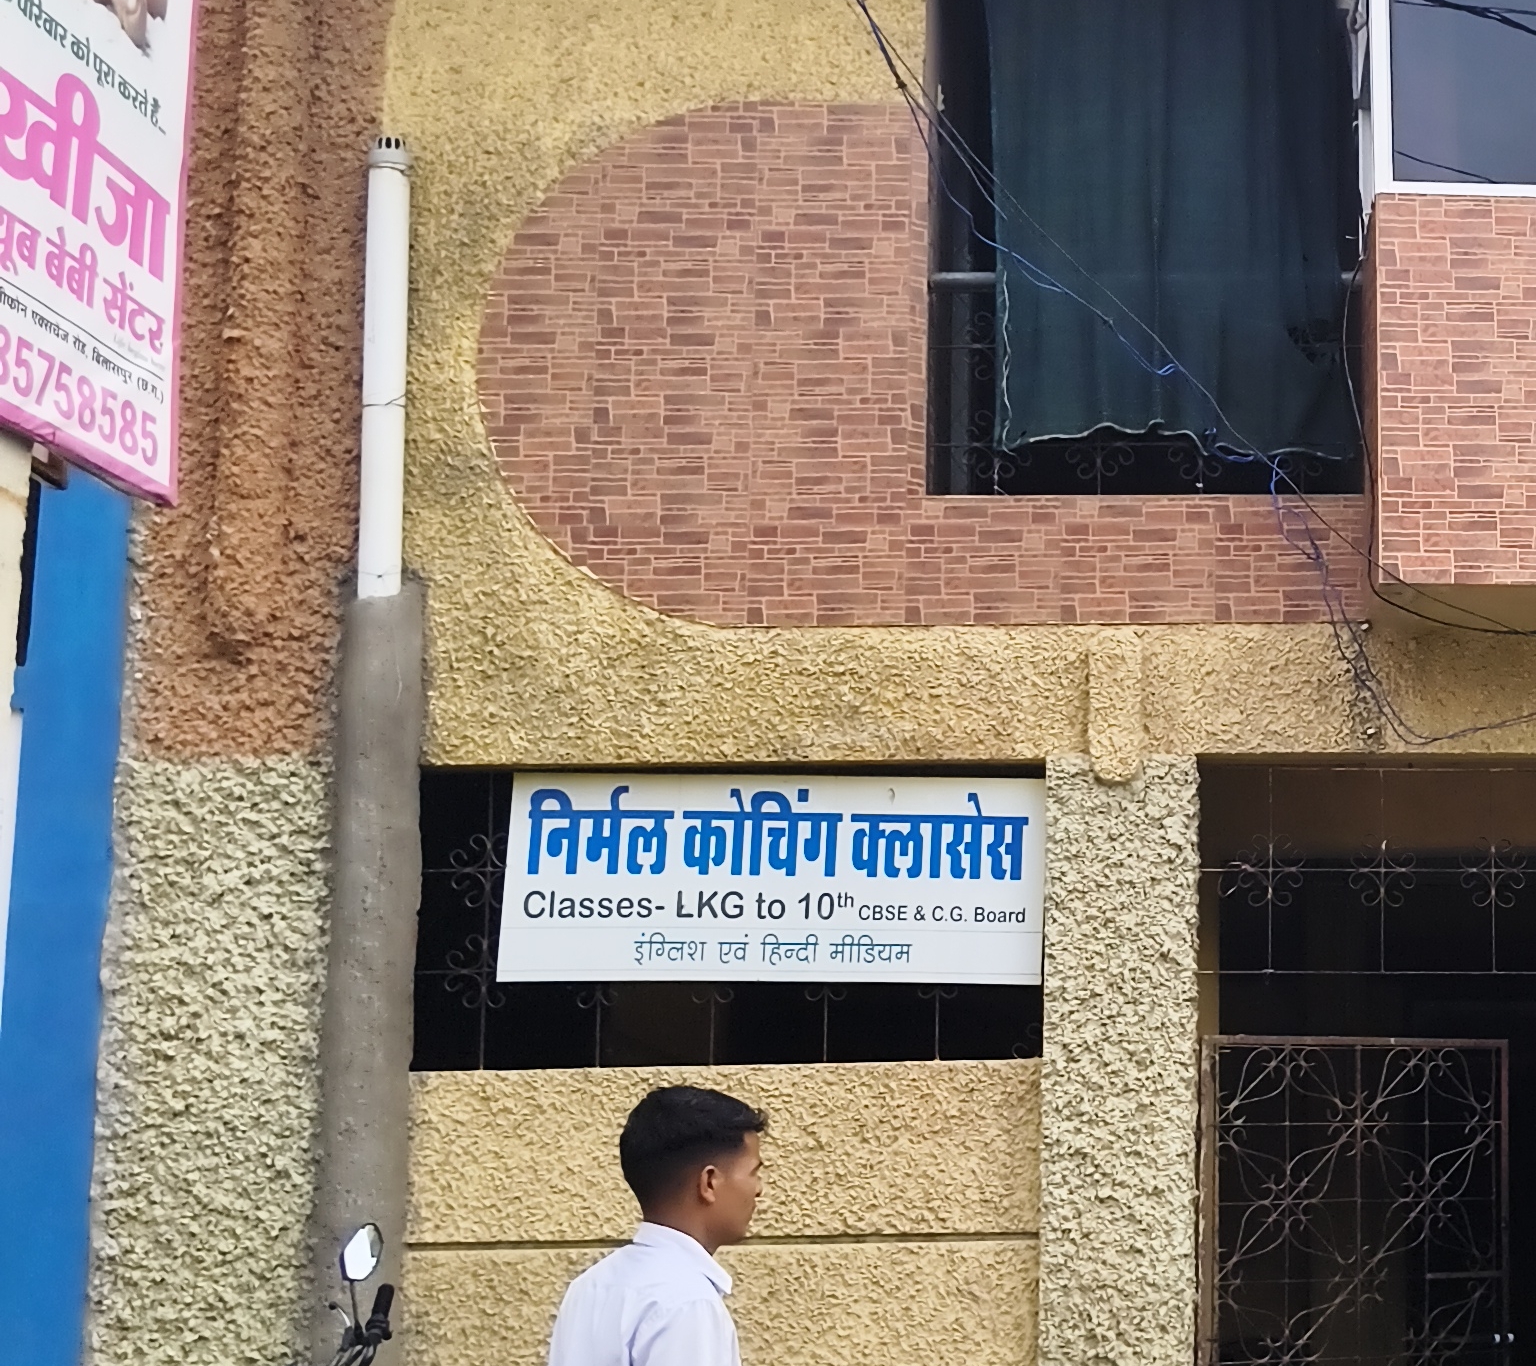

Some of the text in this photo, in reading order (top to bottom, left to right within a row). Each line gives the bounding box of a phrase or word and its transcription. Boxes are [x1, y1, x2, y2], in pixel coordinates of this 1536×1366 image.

[71, 34, 91, 67] को
[93, 52, 116, 88] पूरा
[118, 74, 148, 117] करते
[45, 226, 99, 309] बेबी
[103, 271, 165, 355] सेंटर
[527, 786, 1030, 881] निर्मल कोचिंग क्लासेस
[523, 890, 1027, 924] Classes- LKG to 10th CBSE & C.G. Board
[633, 932, 913, 966] इंग्लिश एवं हिन्दी मीडियम
